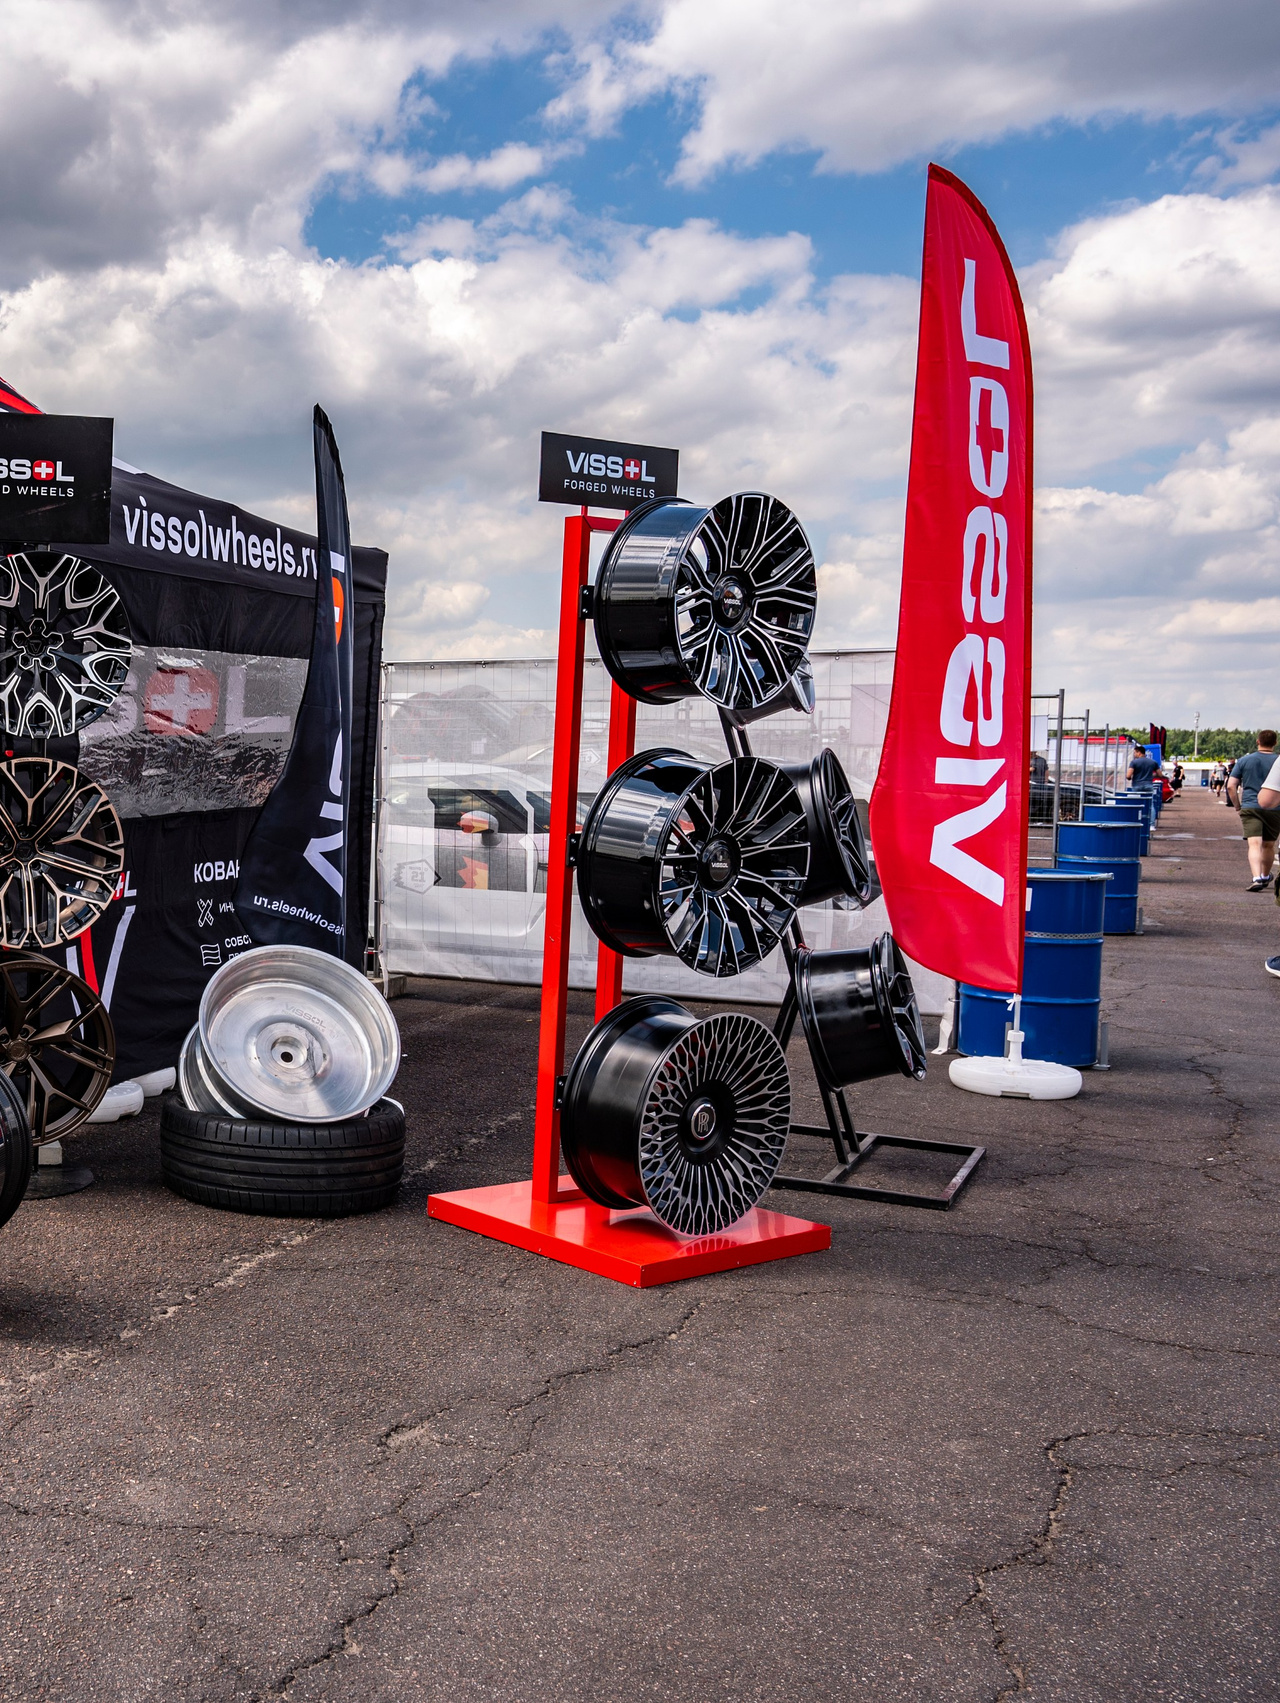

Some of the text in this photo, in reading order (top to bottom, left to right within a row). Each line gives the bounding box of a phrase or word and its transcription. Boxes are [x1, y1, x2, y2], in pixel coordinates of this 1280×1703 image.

[566, 450, 656, 483] VISSOL
[17, 485, 75, 497] WHEELS
[563, 479, 656, 499] FORGED WHEELS
